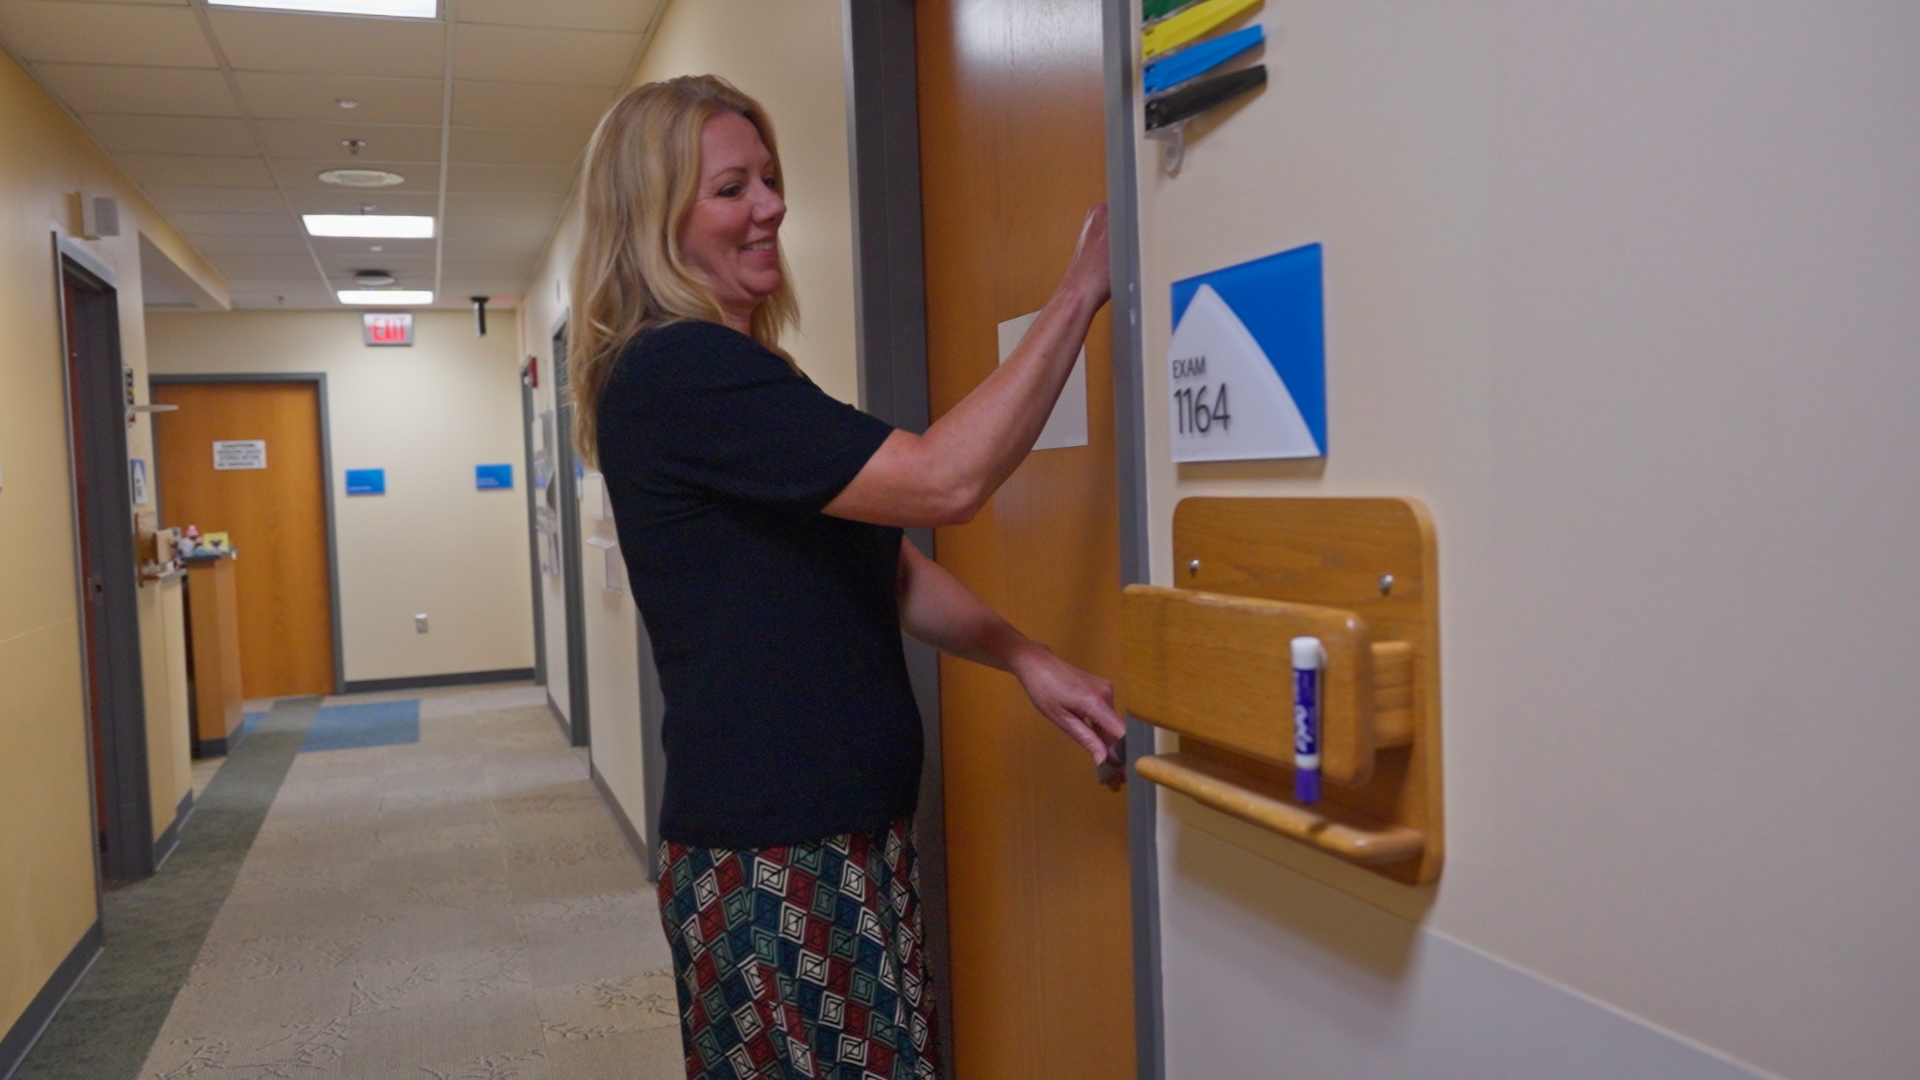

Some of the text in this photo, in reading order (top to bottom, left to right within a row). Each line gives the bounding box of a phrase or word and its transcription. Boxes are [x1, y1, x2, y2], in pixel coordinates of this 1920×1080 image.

[372, 317, 406, 341] EXIT
[1173, 356, 1205, 379] EXAM
[1174, 383, 1230, 434] 1164
